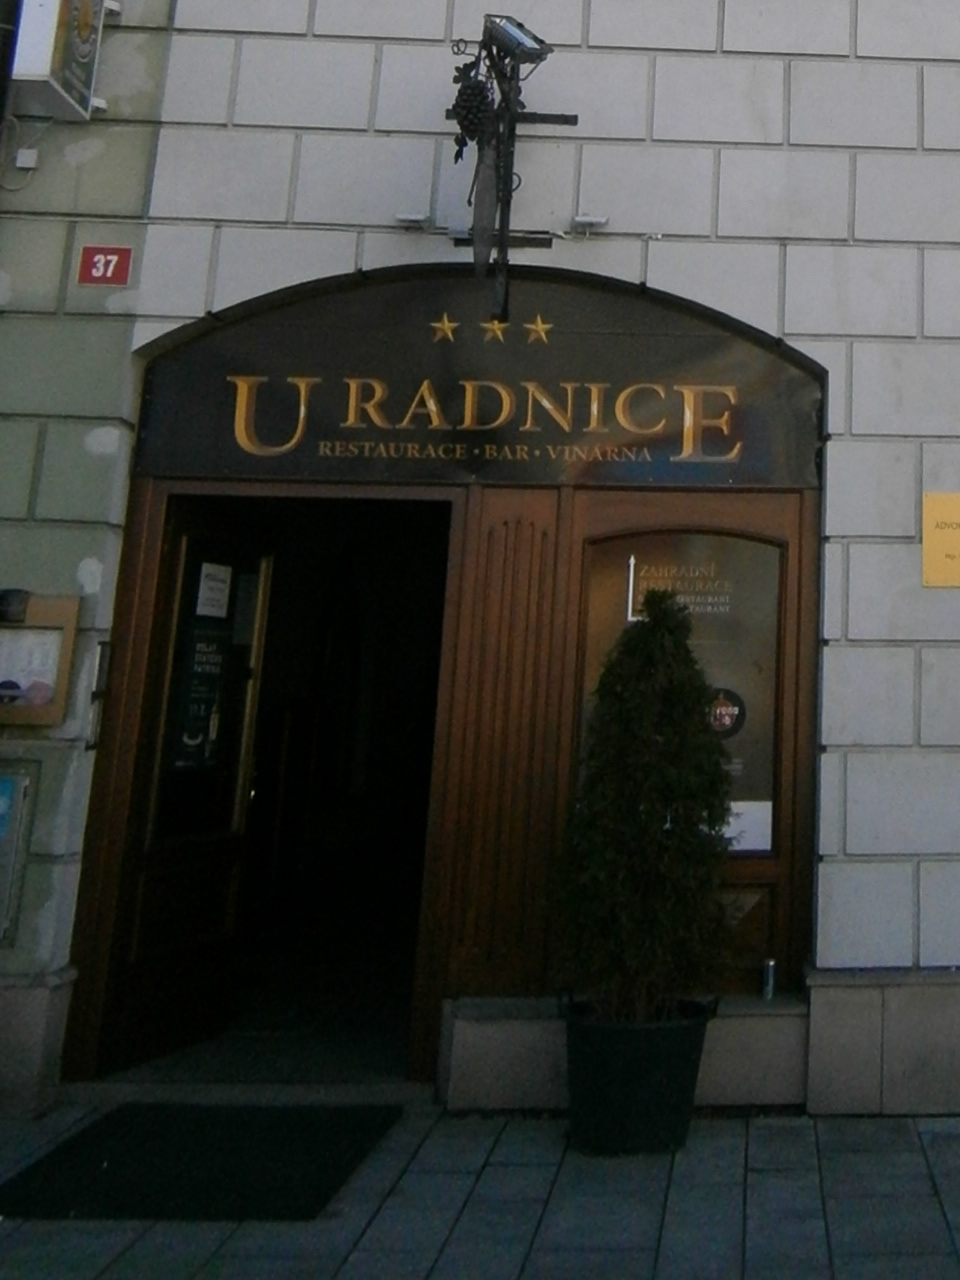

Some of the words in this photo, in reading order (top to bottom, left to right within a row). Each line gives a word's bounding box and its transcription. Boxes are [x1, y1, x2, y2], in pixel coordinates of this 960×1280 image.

[91, 254, 119, 278] 37
[226, 375, 323, 457] U
[340, 377, 743, 463] RADNICE
[318, 440, 467, 460] RESTAURACE
[484, 445, 529, 462] BAR
[639, 562, 715, 578] ZAHRADNÍ
